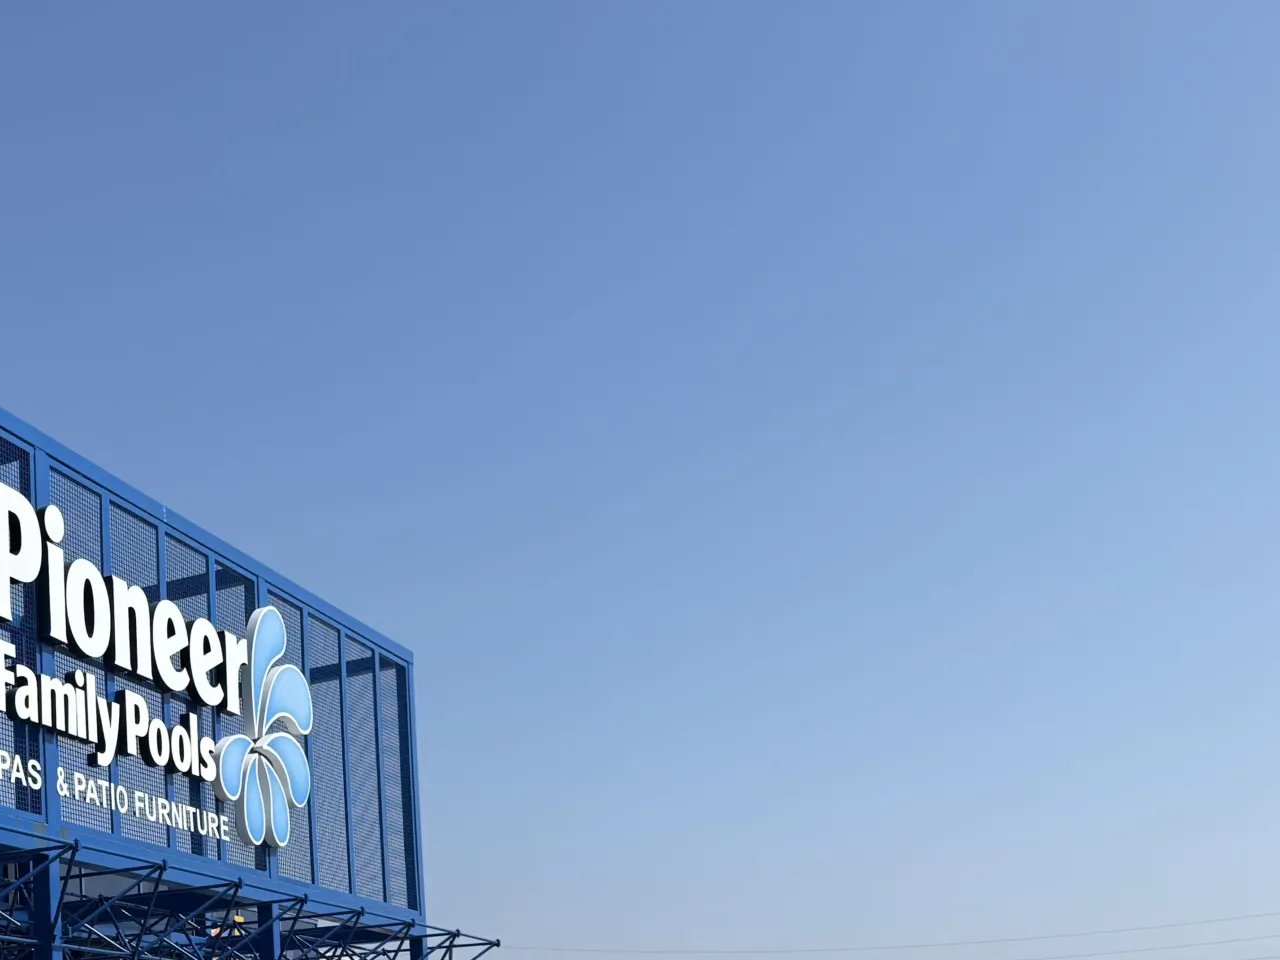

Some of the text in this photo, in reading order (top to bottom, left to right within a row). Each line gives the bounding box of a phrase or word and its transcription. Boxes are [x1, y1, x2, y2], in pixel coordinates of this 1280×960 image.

[121, 689, 217, 782] Pools
[56, 766, 70, 797] &
[74, 772, 129, 814] PATIO
[134, 790, 231, 842] FURNITURE
